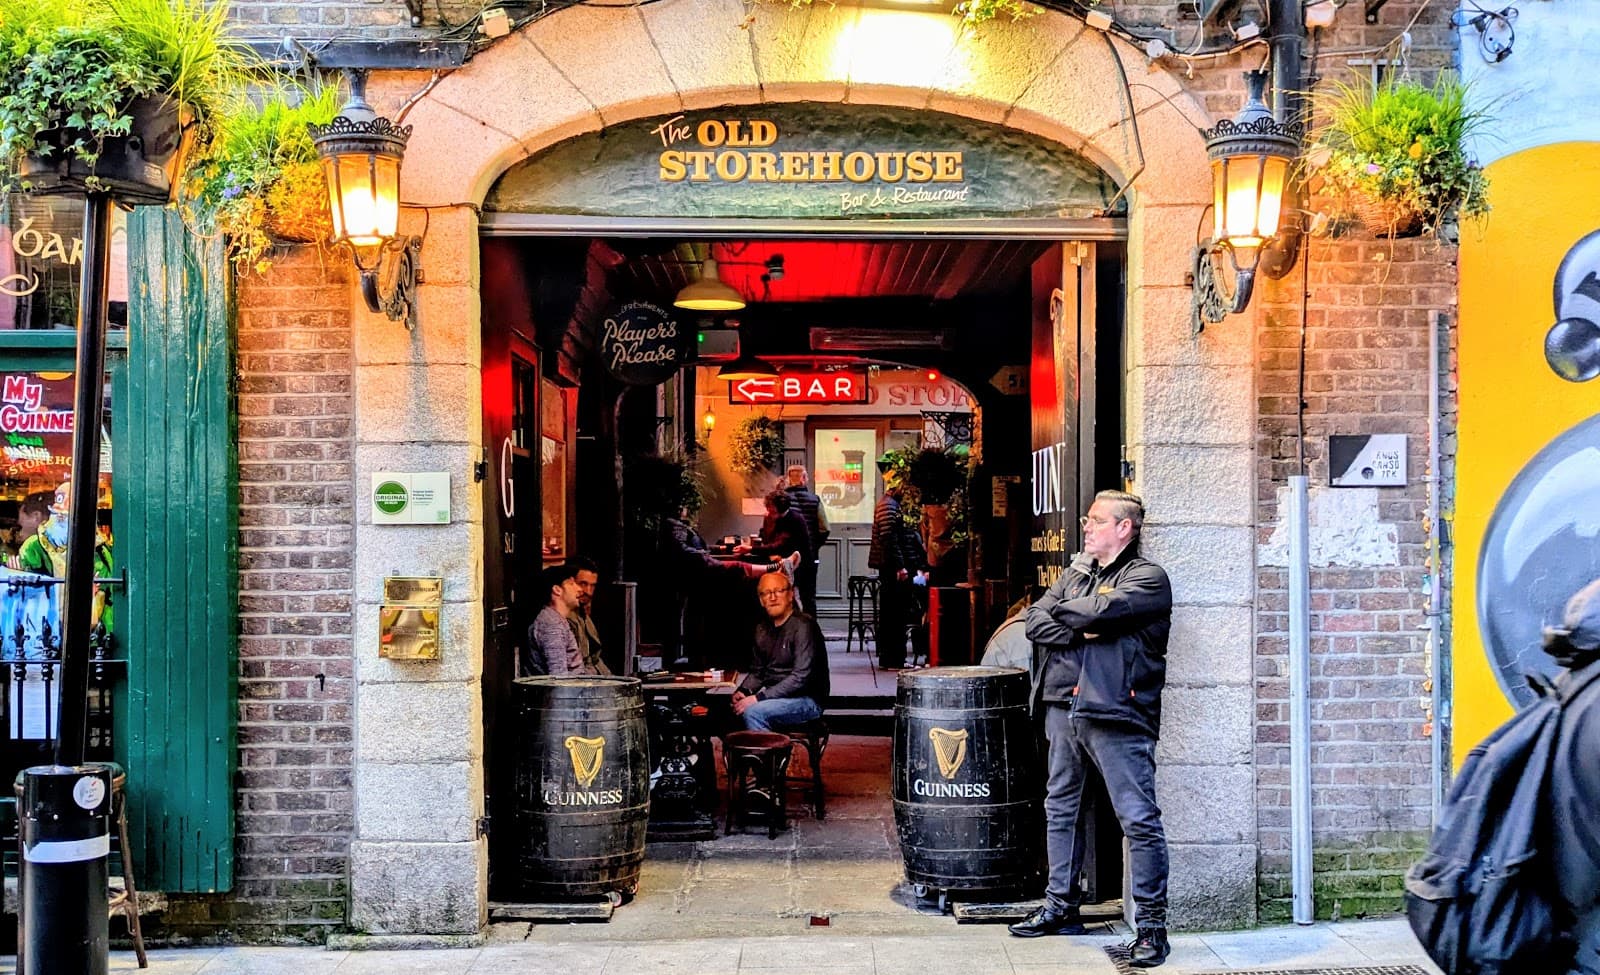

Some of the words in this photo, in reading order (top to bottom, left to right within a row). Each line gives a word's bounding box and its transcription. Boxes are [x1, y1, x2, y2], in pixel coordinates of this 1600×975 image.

[651, 115, 692, 147] The
[697, 119, 778, 147] OLD
[659, 150, 965, 183] STOREHOUSE
[840, 191, 866, 212] Bar
[870, 187, 887, 208] &
[890, 186, 969, 205] Restaurant
[602, 318, 678, 353] Player's
[611, 341, 676, 371] Please
[3, 375, 42, 412] My
[783, 378, 852, 398] BAR
[0, 405, 74, 433] GUINNE
[9, 455, 73, 475] STOREHO
[501, 437, 514, 518] G
[1031, 443, 1065, 517] UIN
[544, 789, 623, 806] GUINNESS
[914, 778, 991, 799] GUINNESS
